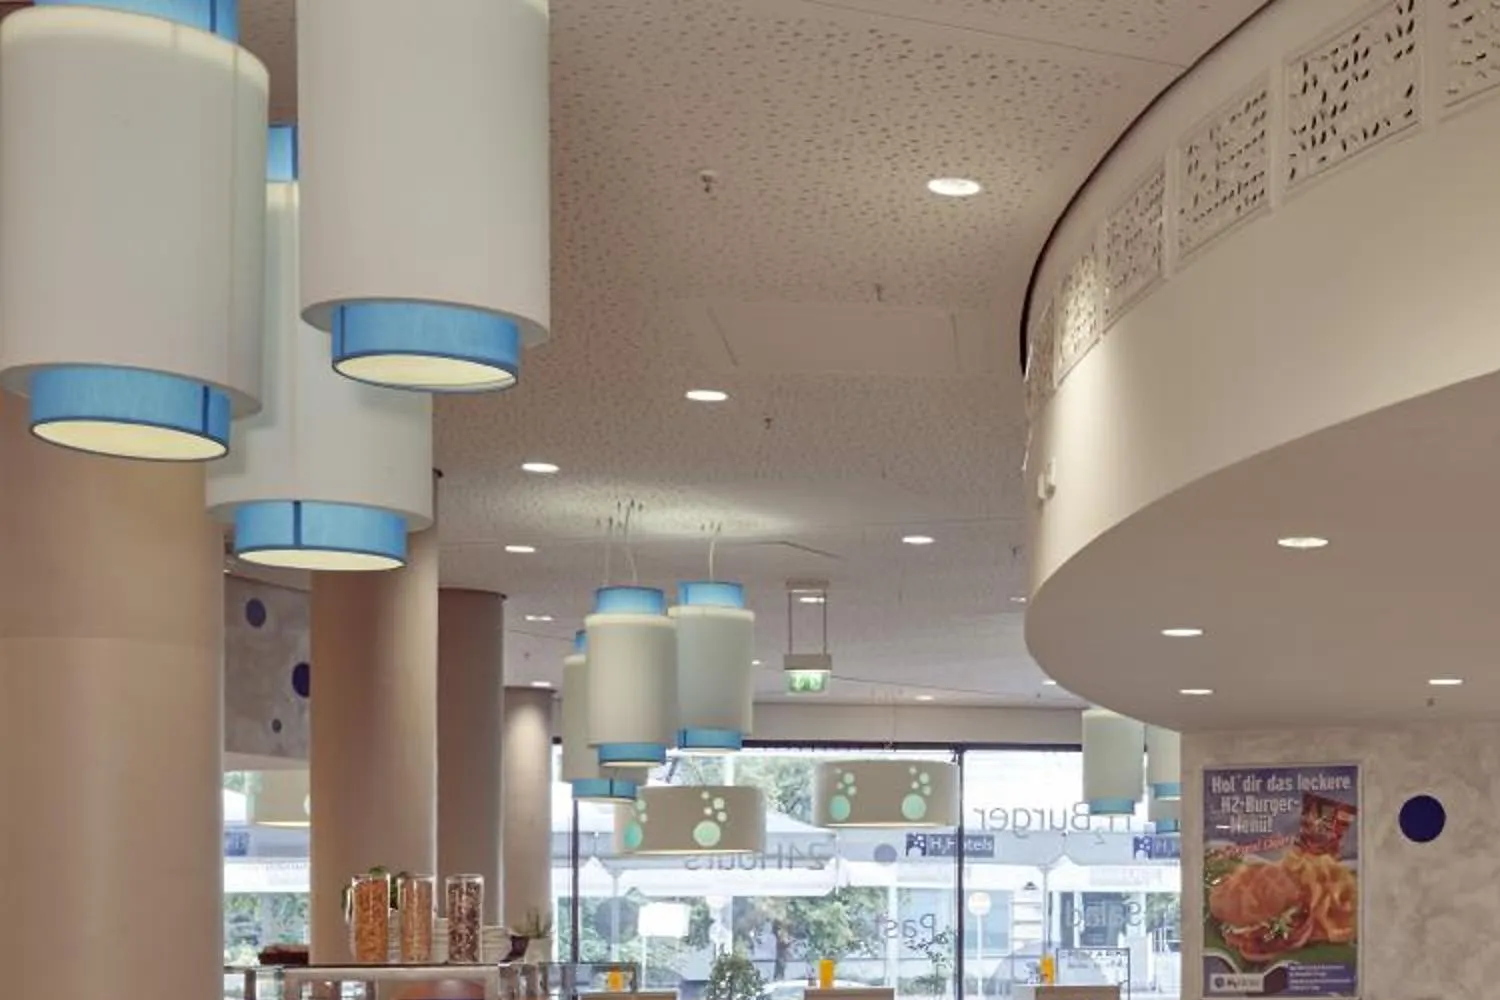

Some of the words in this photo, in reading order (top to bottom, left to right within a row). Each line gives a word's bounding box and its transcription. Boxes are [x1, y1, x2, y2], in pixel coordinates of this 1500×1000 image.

[1243, 775, 1263, 792] dir
[1267, 775, 1293, 791] das
[1298, 773, 1351, 791] leckere
